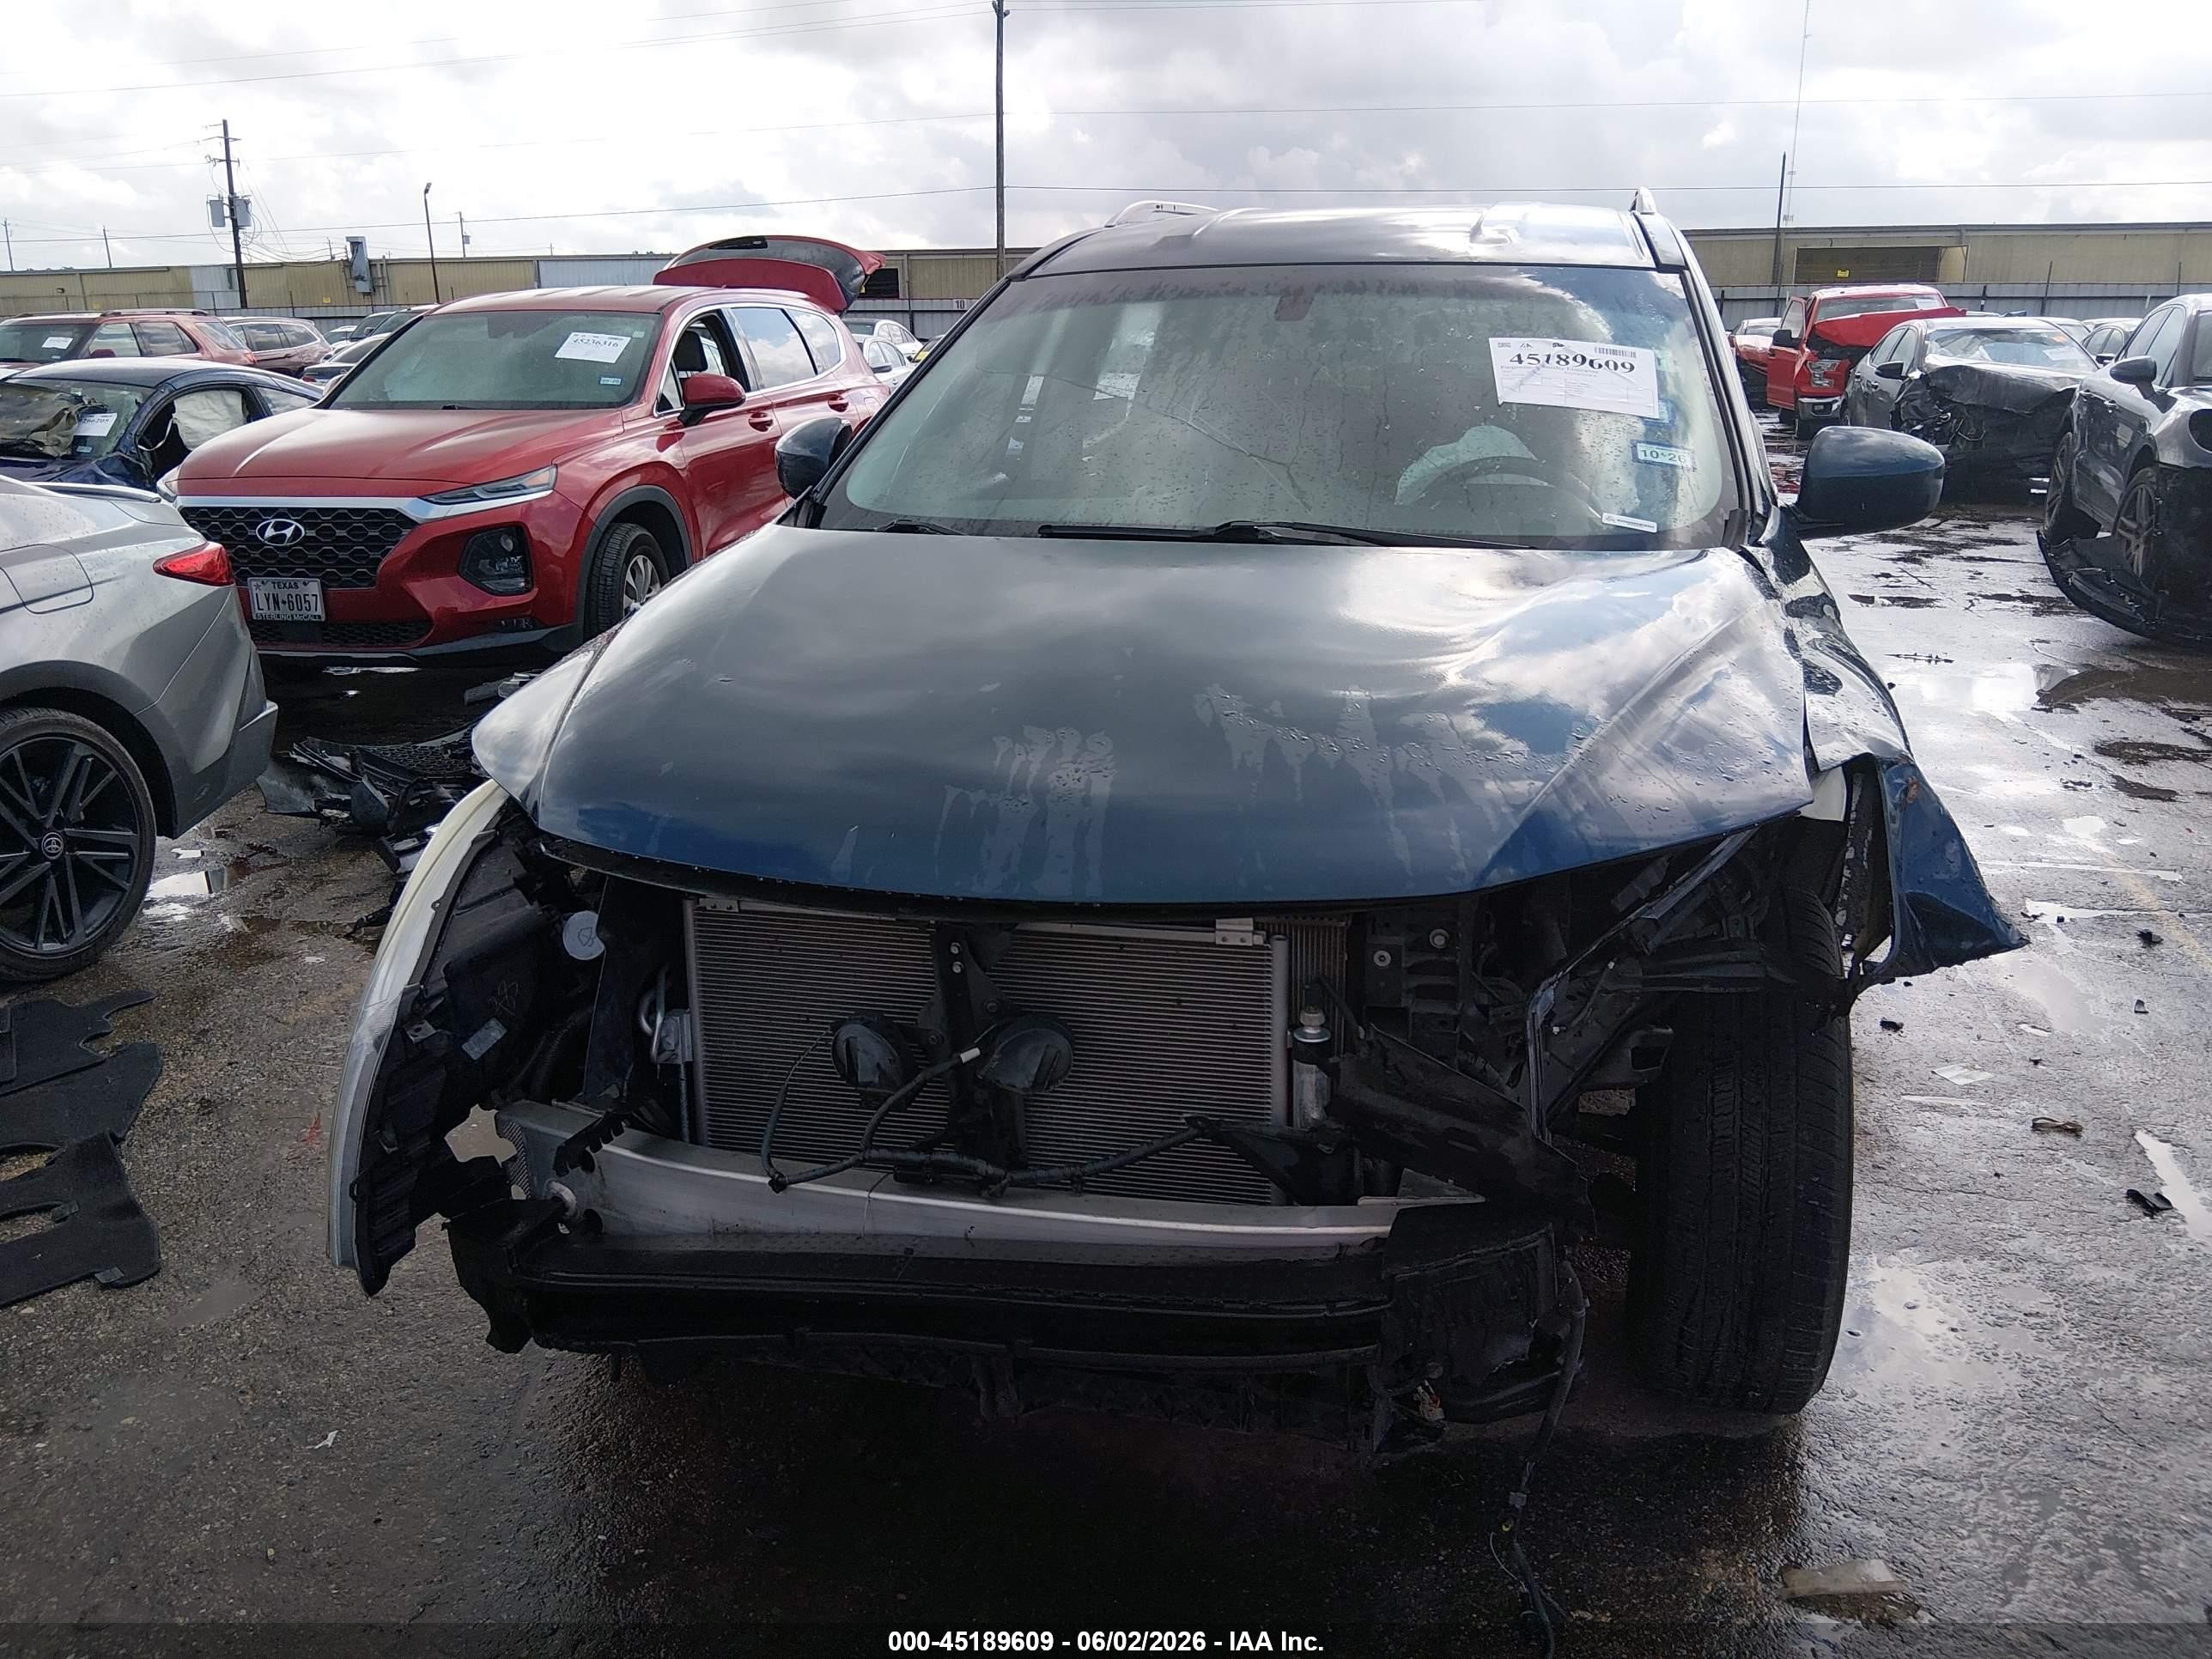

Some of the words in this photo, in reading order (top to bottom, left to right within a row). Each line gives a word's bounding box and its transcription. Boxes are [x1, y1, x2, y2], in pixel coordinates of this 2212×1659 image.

[956, 300, 965, 309] 10
[1510, 353, 1635, 374] 45189609
[271, 581, 300, 590] TEXAS
